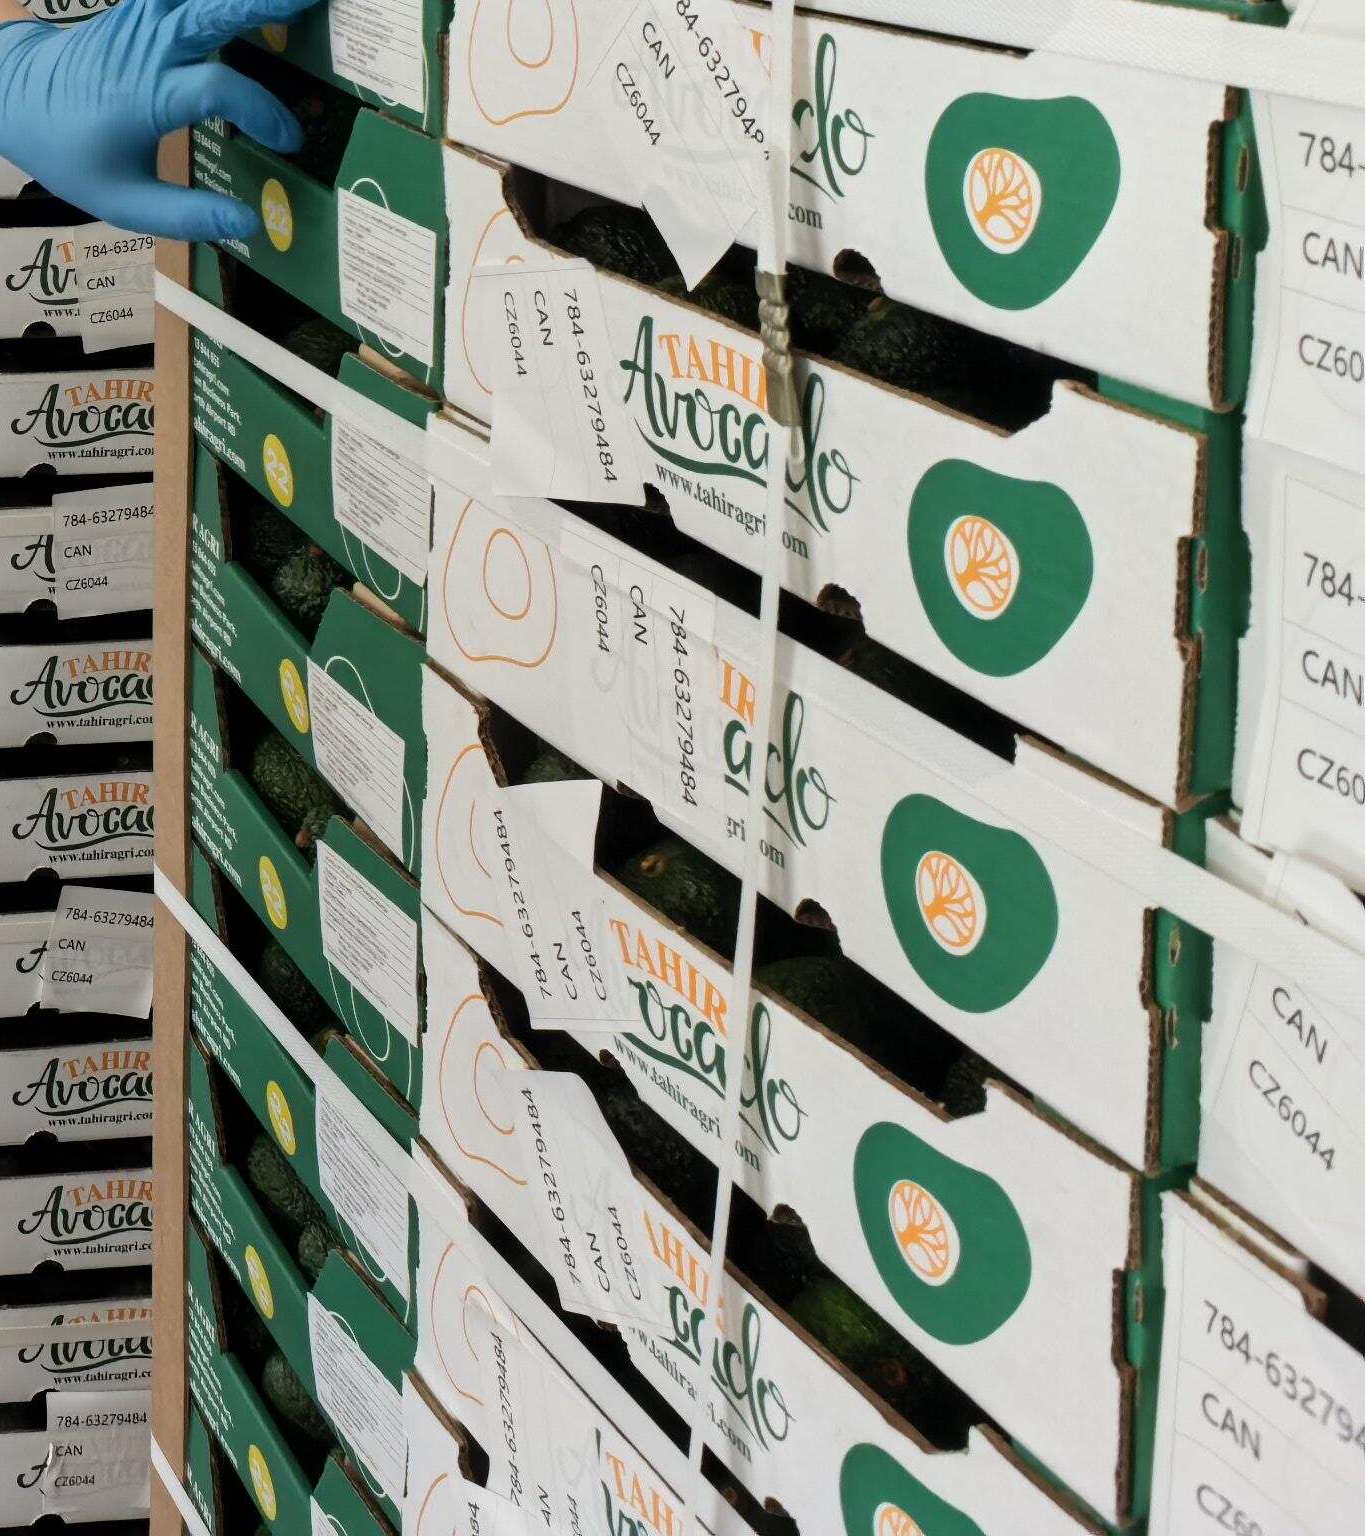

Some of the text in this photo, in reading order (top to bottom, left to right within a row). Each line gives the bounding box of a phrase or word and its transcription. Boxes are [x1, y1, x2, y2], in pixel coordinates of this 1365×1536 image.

[642, 21, 676, 79] CAN
[616, 62, 661, 146] CZ6044
[83, 235, 155, 259] 784-63279
[1302, 232, 1365, 279] CAN
[86, 275, 116, 292] CAN
[89, 307, 134, 325] CZ6044
[503, 291, 527, 376] CZ6044
[533, 290, 553, 346] CAN
[1298, 333, 1365, 381] CZ60
[65, 379, 155, 408] TAHIR
[564, 288, 617, 481] 784-63279484
[268, 447, 289, 496] 22
[62, 504, 155, 528] 784-63279484
[655, 464, 809, 560] www.tahiragriom
[63, 545, 92, 560] CAN
[65, 575, 108, 592] CZ6044
[591, 564, 610, 653] CZ6044
[629, 584, 648, 646] CAN
[62, 650, 152, 679] TAHIR
[1301, 649, 1365, 707] CAN
[669, 605, 697, 807] 784-63279484
[61, 781, 150, 812] TAHIR
[1297, 747, 1365, 808] CZ60
[65, 906, 155, 929] 784-63279484
[493, 809, 553, 1000] 784-63279484
[57, 938, 87, 953] CAN
[553, 941, 578, 1000] CAN
[571, 910, 607, 1002] CZ6044
[51, 969, 94, 985] CZ6044
[609, 917, 729, 1040] TAHIR
[1271, 985, 1329, 1065] CAN
[62, 1050, 151, 1080] TAHIR
[613, 1035, 761, 1172] www.tahiragriom
[1247, 1058, 1337, 1170] CZ6044
[17, 1185, 153, 1238] Avoca
[67, 1180, 153, 1208] TAHIR
[521, 1087, 582, 1286] 784-63279484
[52, 1241, 152, 1257] www.tahiragri.c
[585, 1232, 611, 1293] CAN
[606, 1206, 643, 1301] CZ6044
[52, 1370, 152, 1385] www.tahiragri.c
[1202, 1298, 1365, 1452] 784-632794
[56, 1413, 148, 1428] 784-63279484
[490, 1331, 523, 1507] 784-63279484
[1200, 1391, 1263, 1463] CAN
[55, 1444, 83, 1457] CAN
[54, 1474, 96, 1489] CZ6044
[536, 1483, 552, 1527] AN
[1195, 1482, 1264, 1536] CZ60
